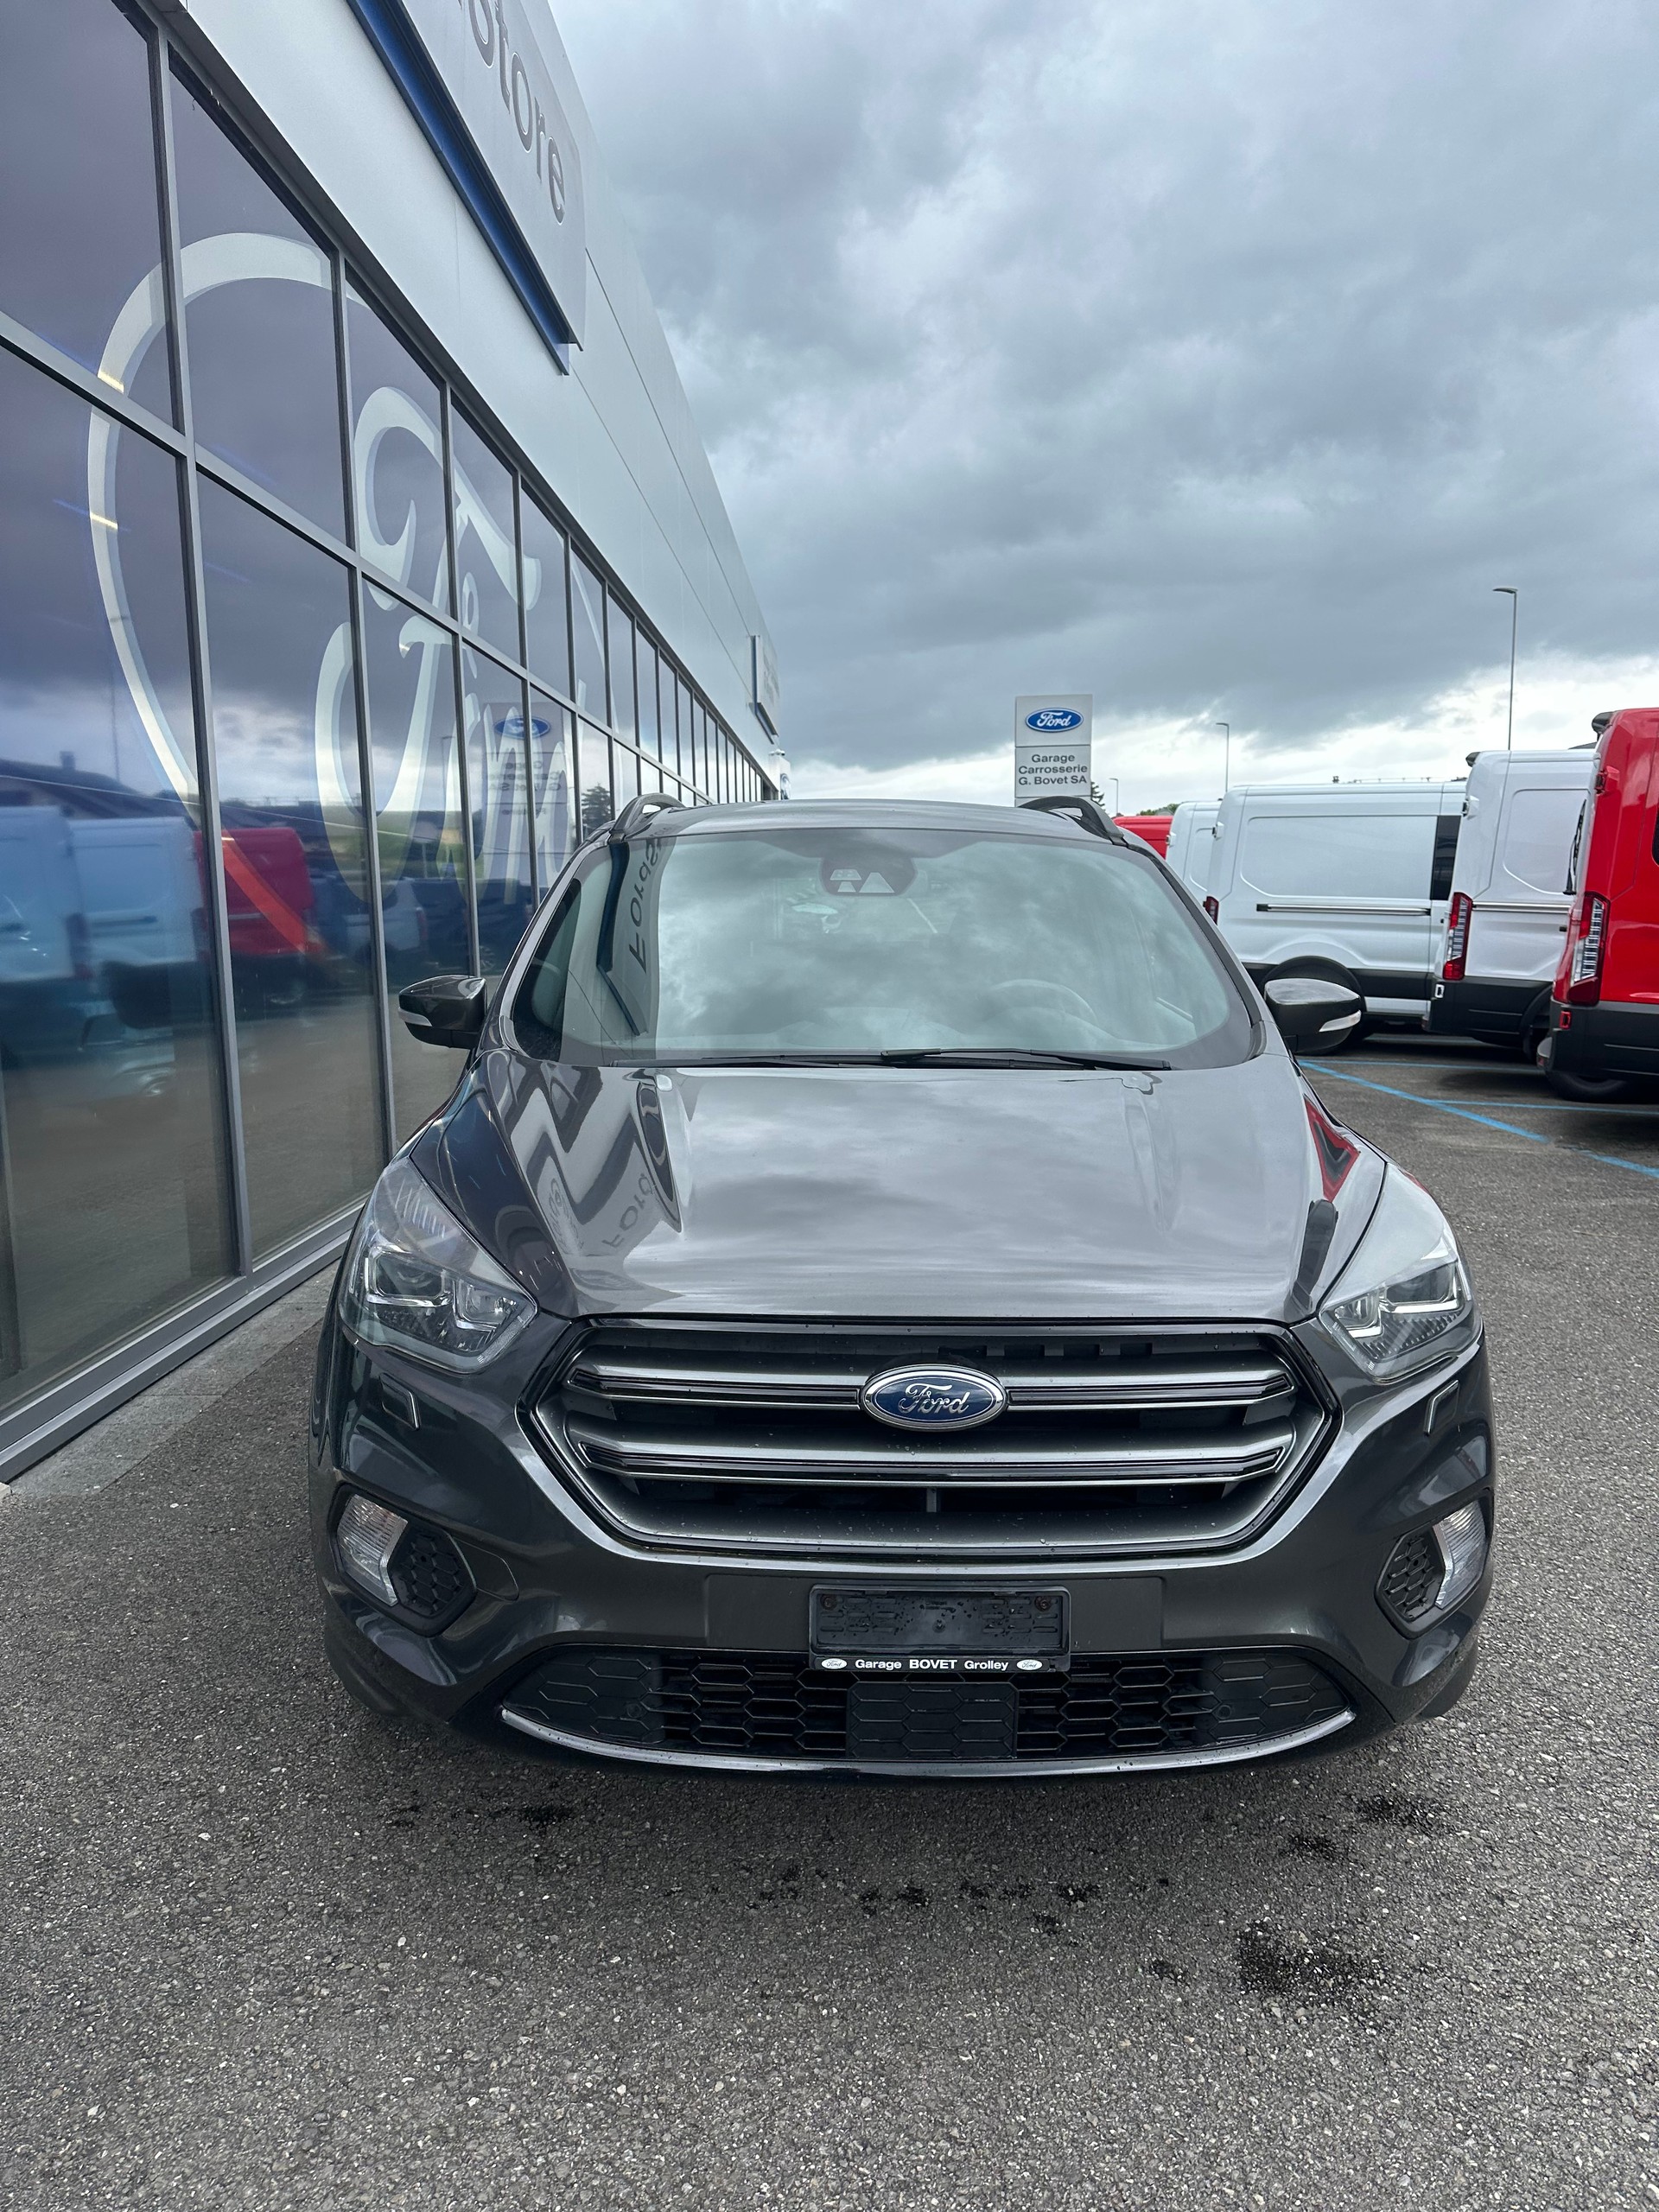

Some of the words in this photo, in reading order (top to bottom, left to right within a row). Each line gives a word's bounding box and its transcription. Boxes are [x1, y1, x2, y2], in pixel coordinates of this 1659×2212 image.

[1037, 711, 1072, 727] Ford
[1032, 754, 1076, 764] Garage
[1019, 765, 1088, 774] Carrosserie
[1019, 777, 1032, 785] G.
[1034, 775, 1069, 785] Bovet
[1071, 775, 1087, 784] SA
[898, 1382, 970, 1414] Ford
[855, 1659, 902, 1671] Garage
[909, 1659, 957, 1669] BOVET
[964, 1660, 1009, 1671] Grolley
